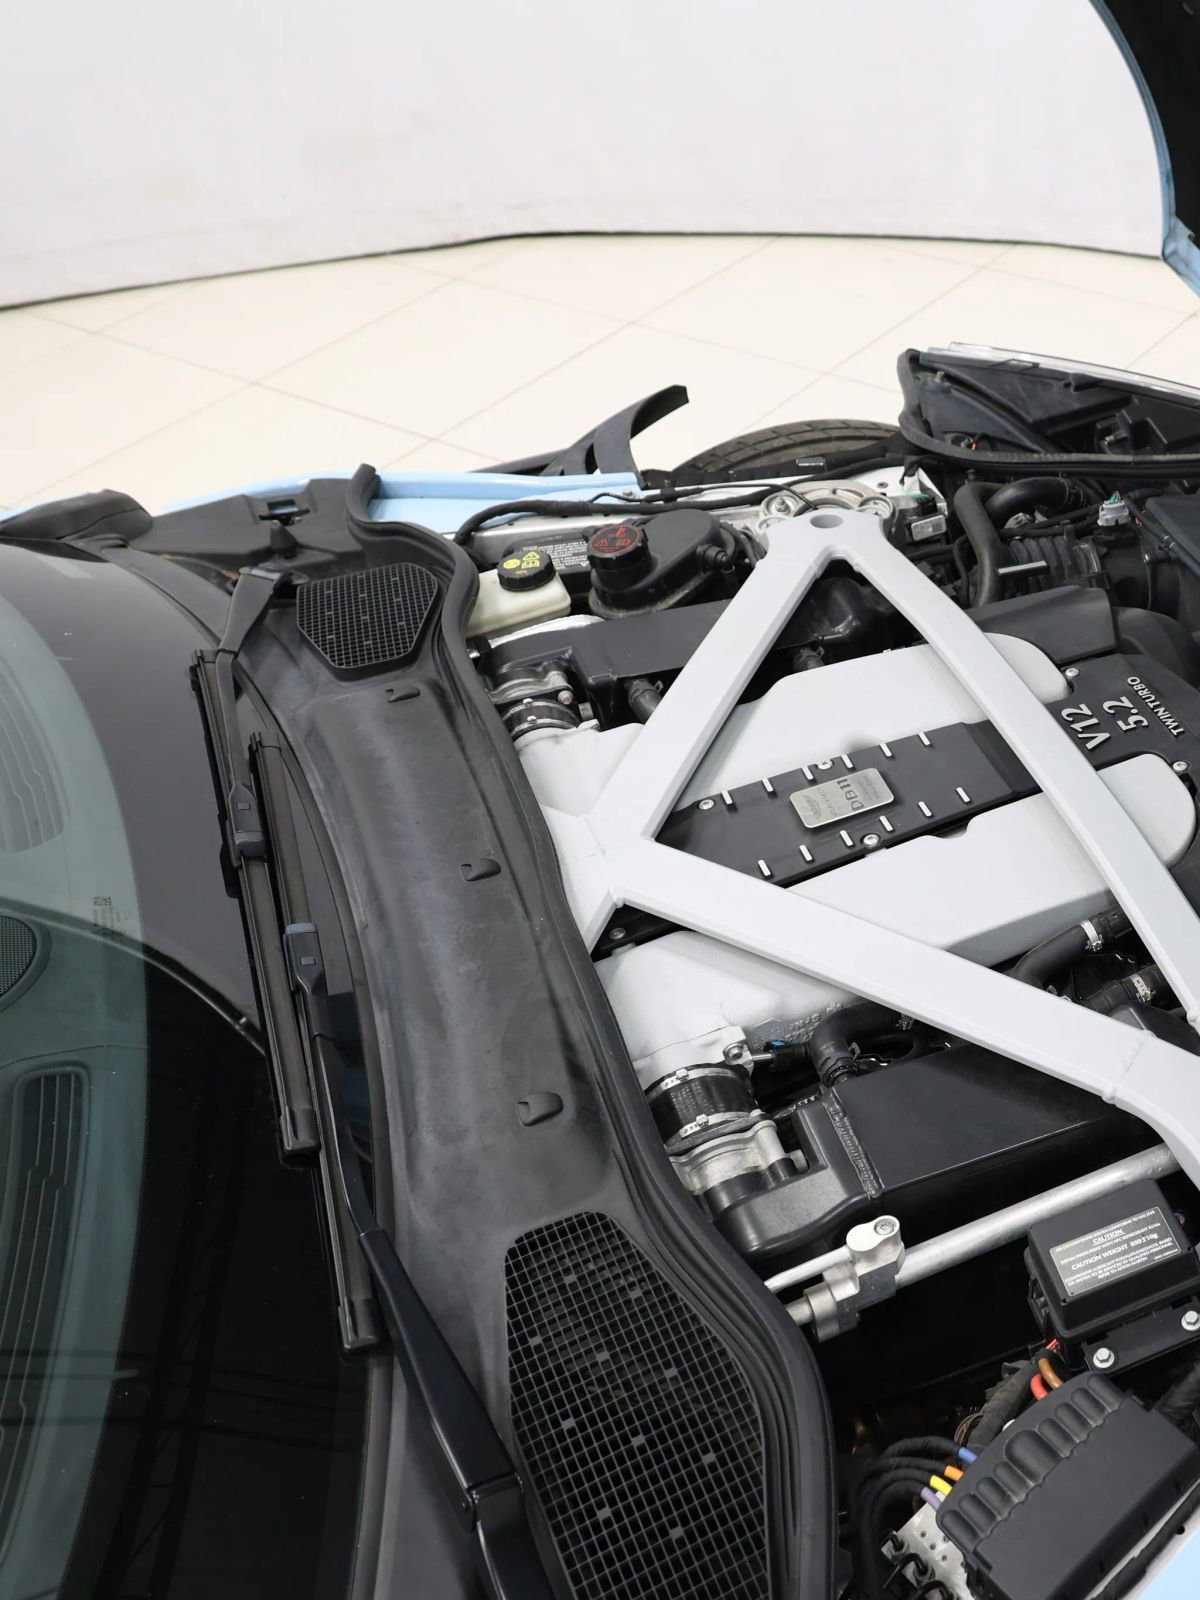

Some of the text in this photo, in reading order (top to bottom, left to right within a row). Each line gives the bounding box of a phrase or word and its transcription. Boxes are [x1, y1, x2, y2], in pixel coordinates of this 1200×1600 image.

[1102, 696, 1149, 731] 5.2
[1127, 676, 1184, 736] TWIN TURBO
[1061, 703, 1111, 750] V12
[836, 778, 864, 811] DB11
[1092, 1228, 1123, 1244] CAUTION
[1071, 1255, 1101, 1270] CAUTION
[1102, 1244, 1128, 1257] WEIGHT
